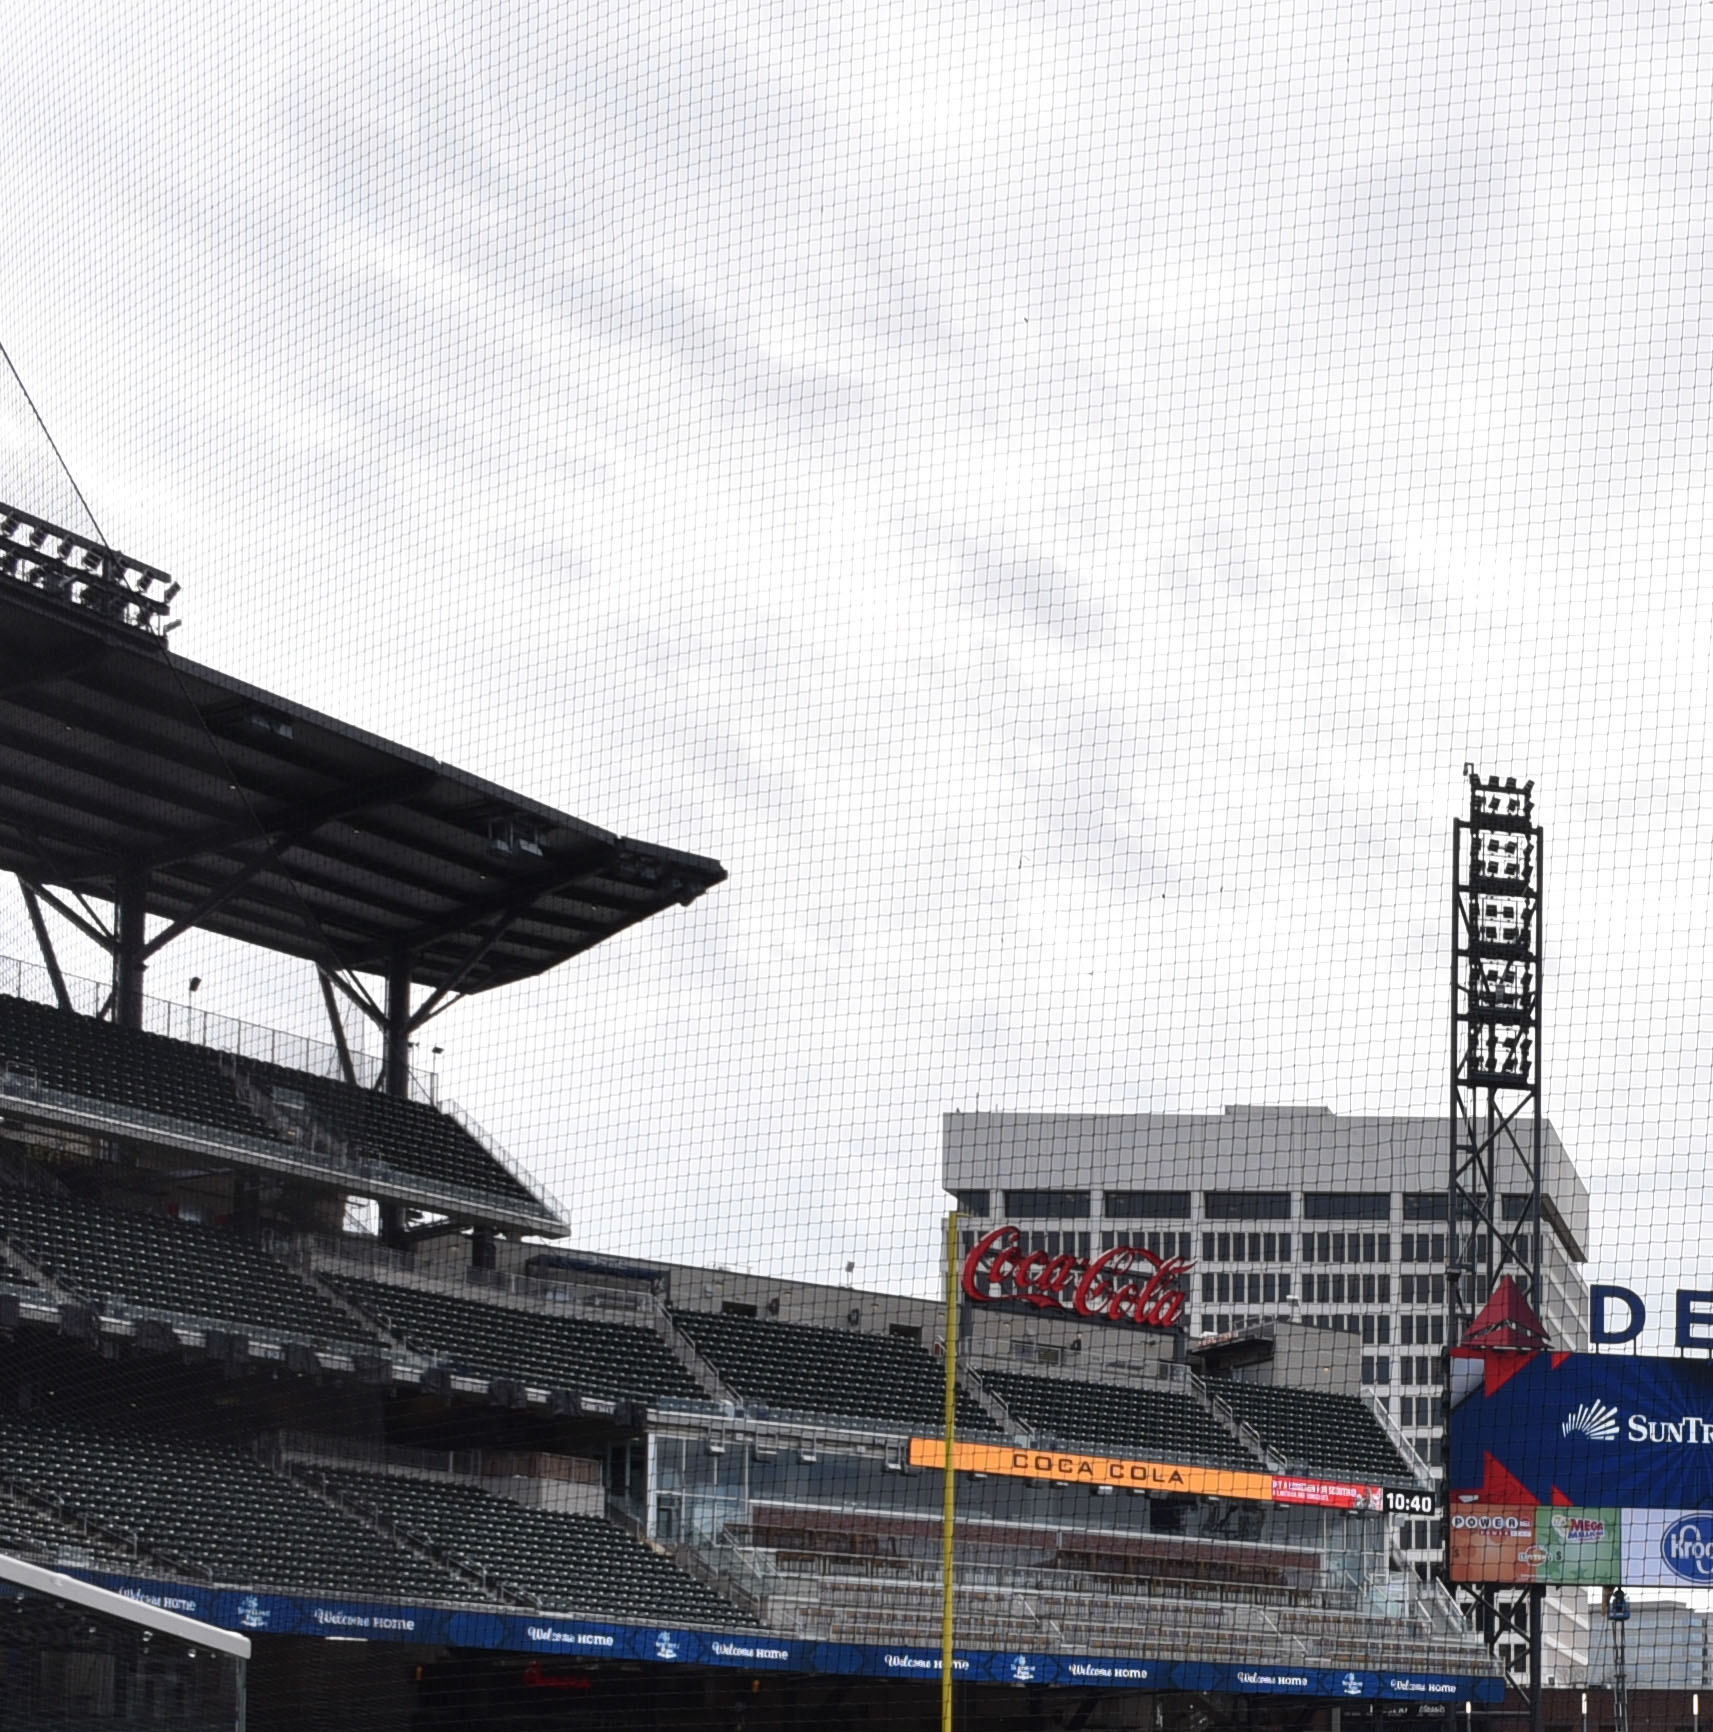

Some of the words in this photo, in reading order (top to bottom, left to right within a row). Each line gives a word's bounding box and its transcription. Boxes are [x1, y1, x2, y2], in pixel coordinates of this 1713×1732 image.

[962, 1226, 1198, 1327] Coca-Cola
[1012, 1452, 1094, 1478] COCA
[1109, 1460, 1185, 1486] COLA
[1386, 1492, 1432, 1512] 10:40
